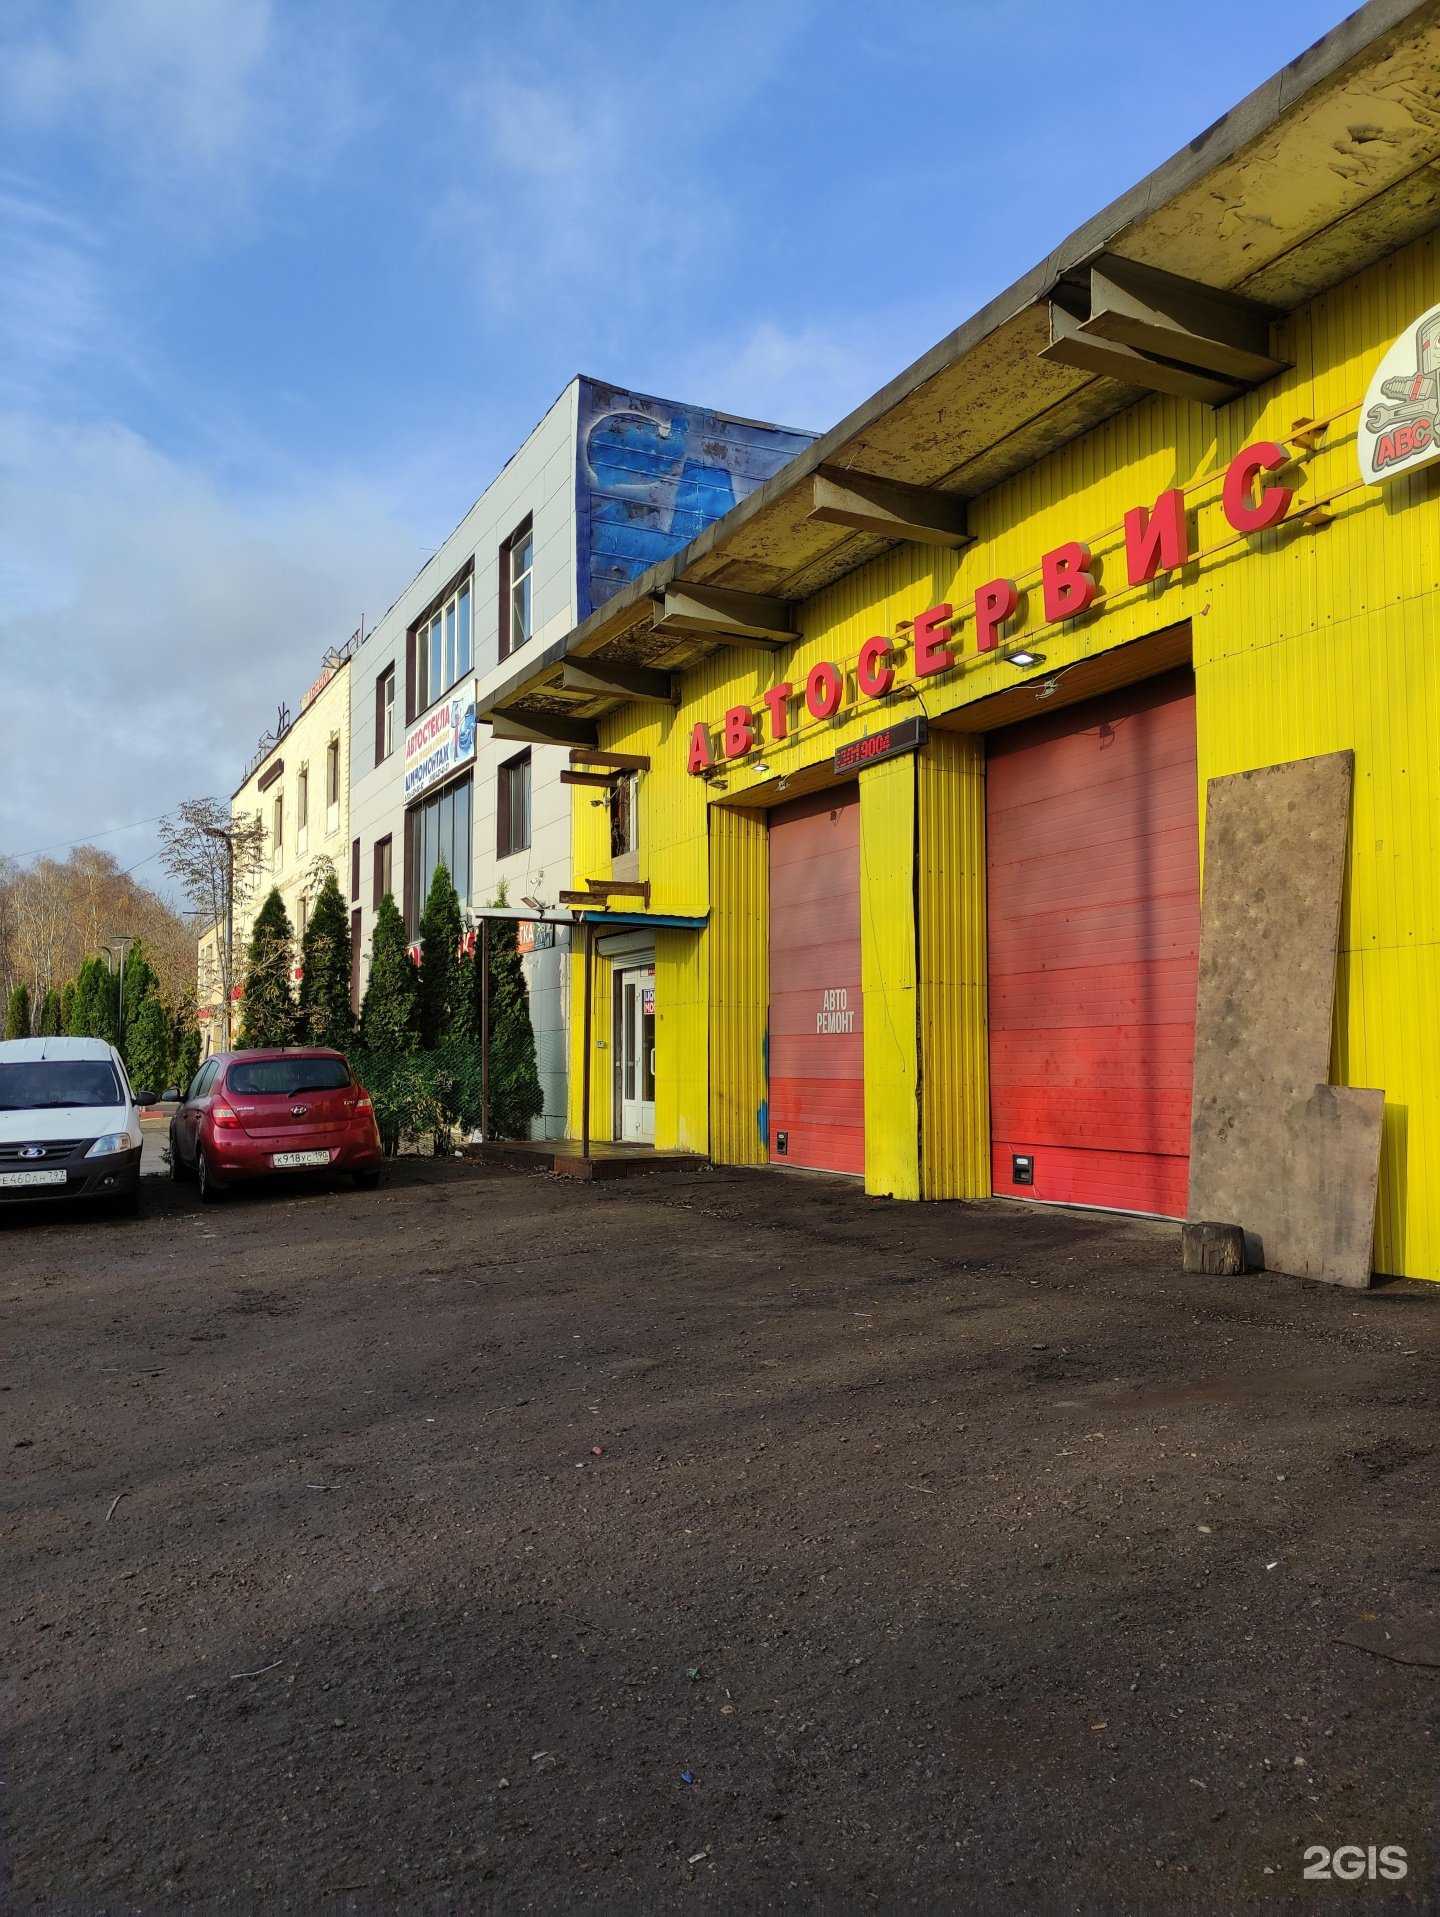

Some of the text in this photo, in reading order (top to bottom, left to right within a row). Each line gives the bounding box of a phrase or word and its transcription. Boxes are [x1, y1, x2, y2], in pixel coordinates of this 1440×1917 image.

[687, 441, 1294, 775] АВТОСЕРВИС
[406, 704, 450, 758] АВТОСТЕКЛА
[823, 988, 847, 1011] АВТО
[816, 1010, 854, 1034] РЕМОНТ
